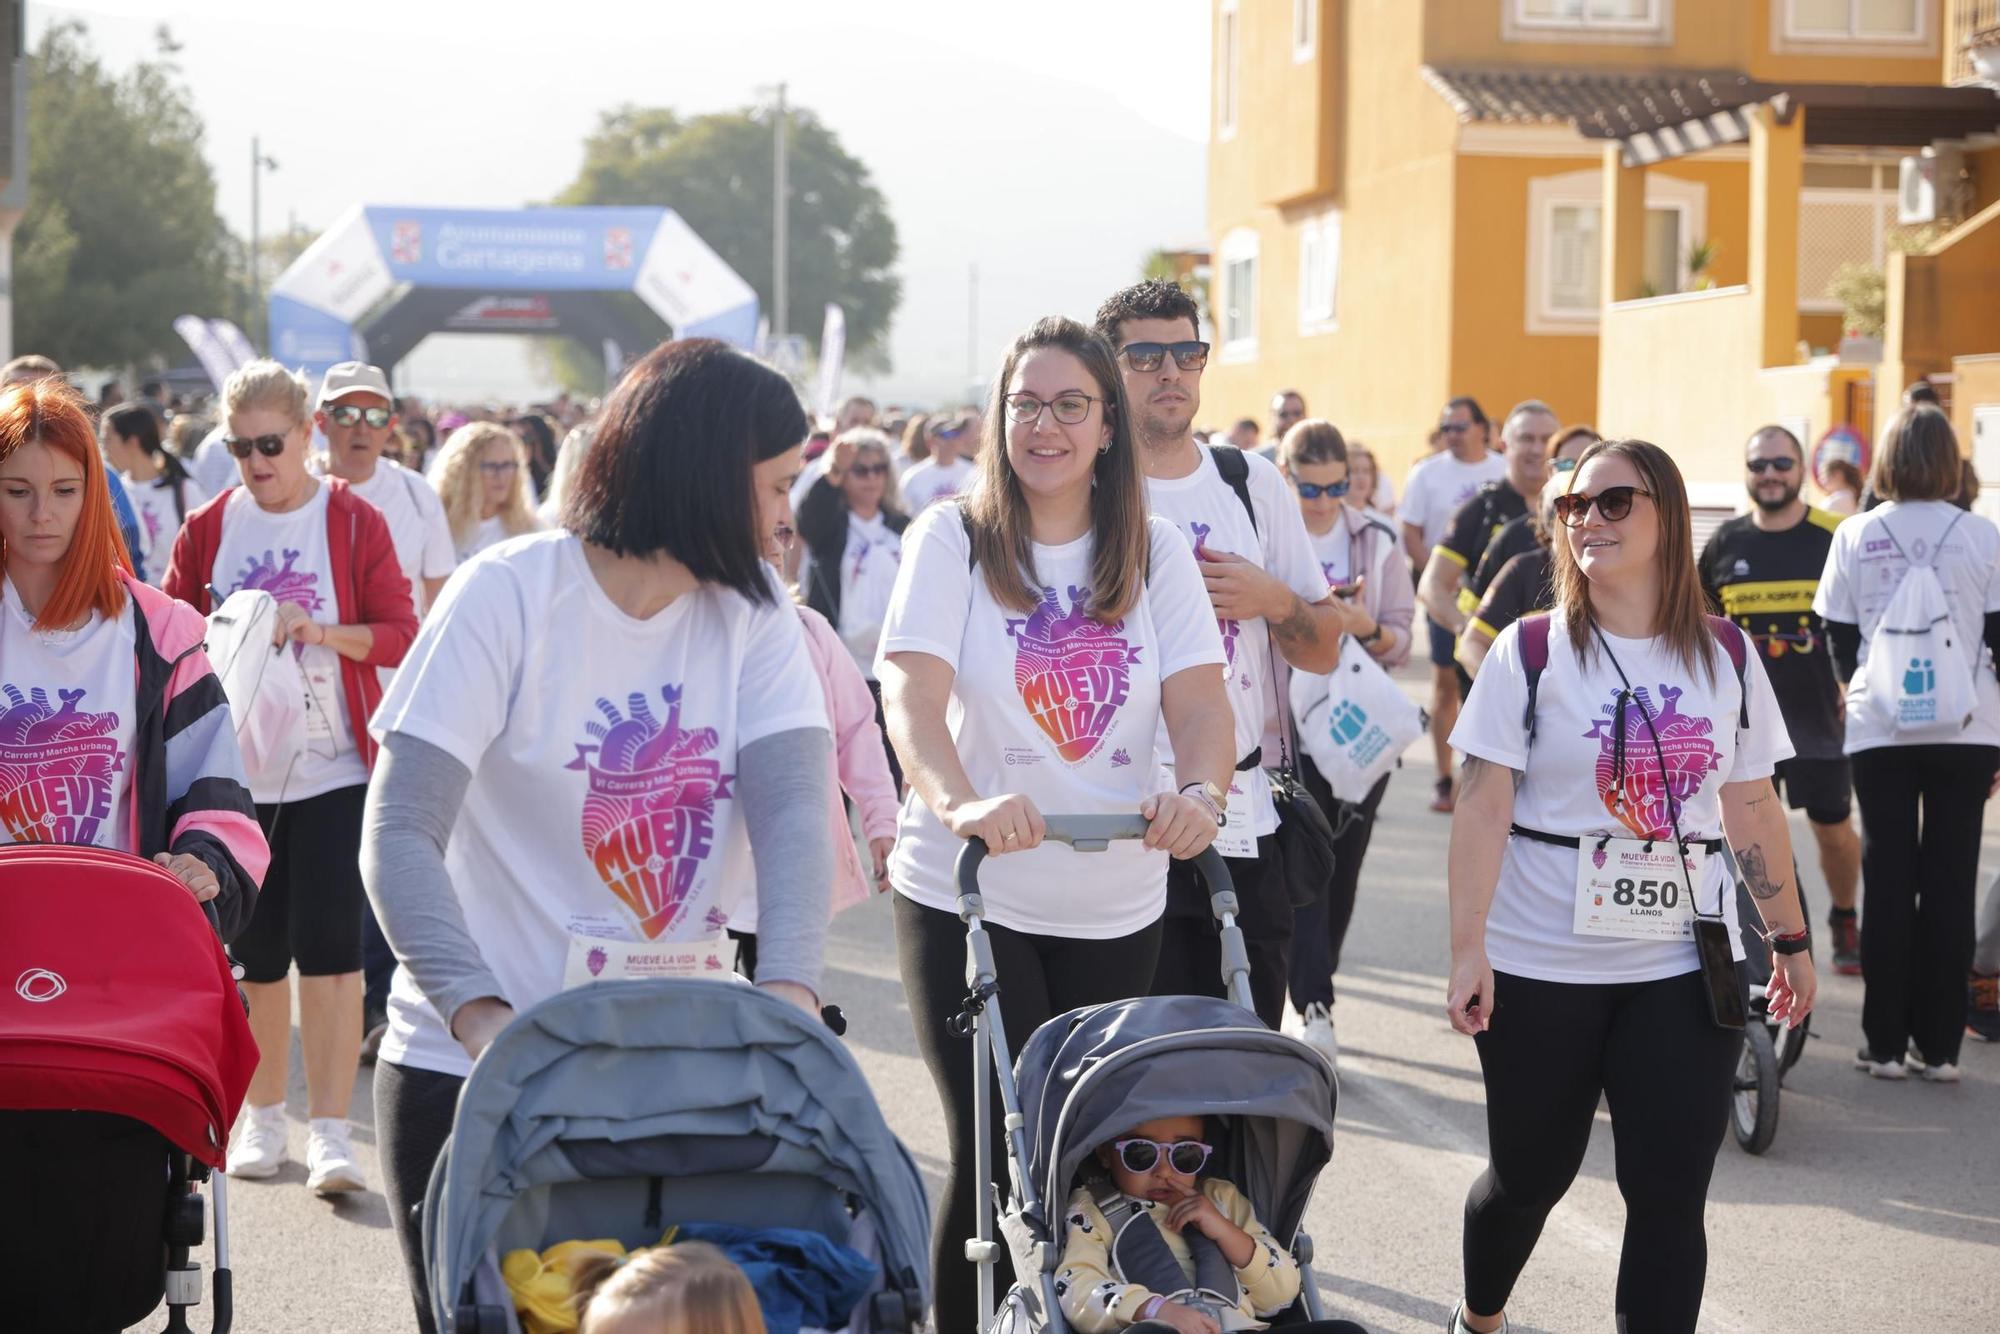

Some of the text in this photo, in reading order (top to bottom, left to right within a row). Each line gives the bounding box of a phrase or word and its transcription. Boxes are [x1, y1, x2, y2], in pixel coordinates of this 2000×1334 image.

[436, 239, 585, 276] Cartagena
[1031, 643, 1061, 654] Carrera
[1066, 641, 1094, 651] Marcha
[1022, 666, 1130, 715] MUEVE
[1031, 702, 1117, 746] VIDA
[4, 742, 113, 760] Carrera y Marcha Urbana
[1683, 742, 1710, 751] Urbana
[595, 777, 605, 788] VI
[607, 779, 646, 791] Carrera
[676, 765, 713, 776] Urbana
[0, 776, 112, 835] MUEVE
[1620, 852, 1676, 863] MUEVE LA VIDA
[1612, 878, 1679, 909] 850
[1630, 908, 1663, 917] LLANOS
[626, 954, 696, 965] MUEVE LA VIDA
